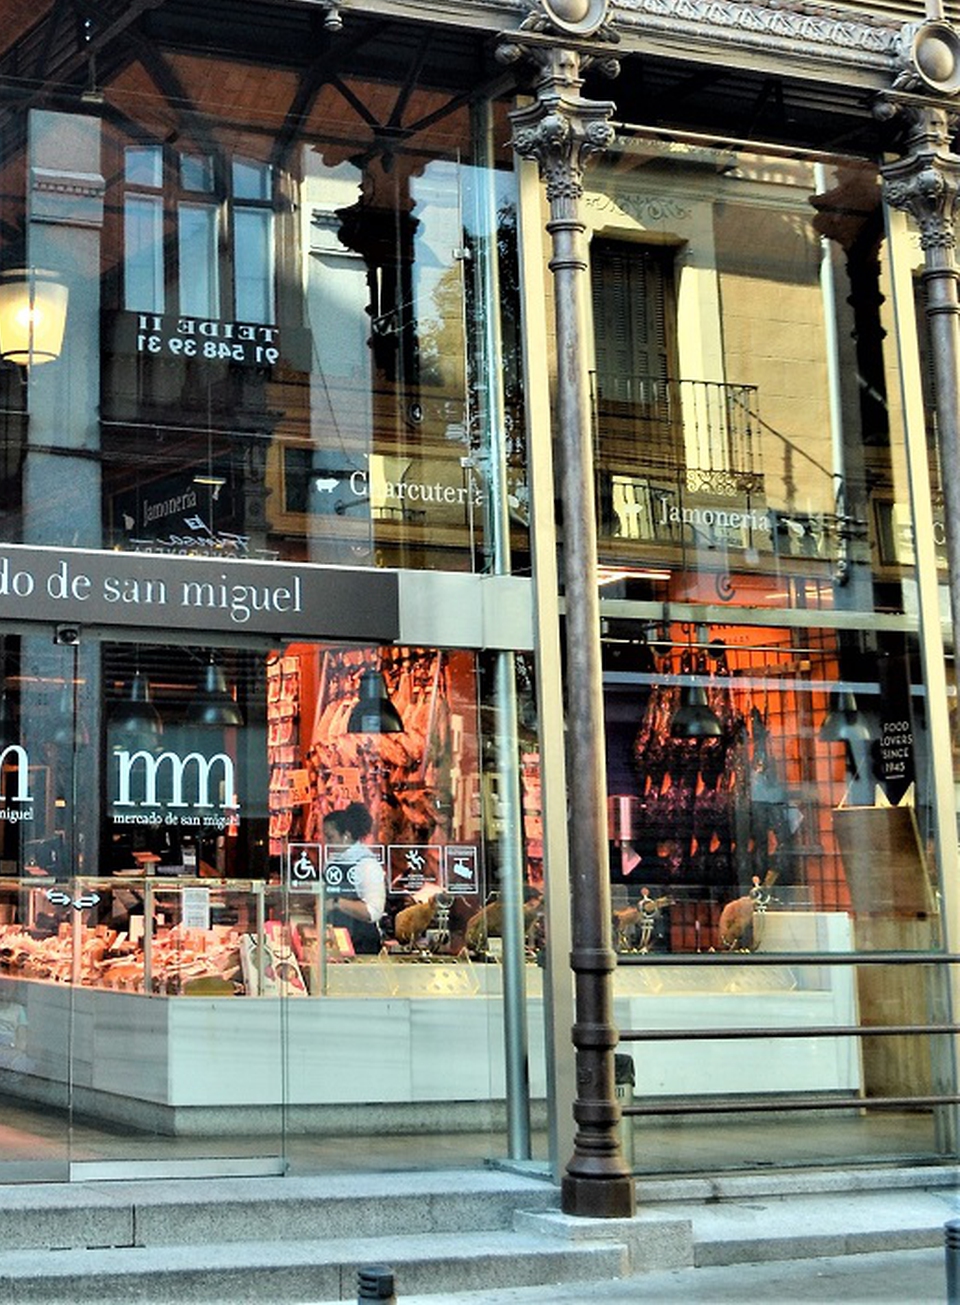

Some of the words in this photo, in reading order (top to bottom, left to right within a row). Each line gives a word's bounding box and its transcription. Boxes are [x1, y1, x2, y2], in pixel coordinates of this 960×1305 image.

[349, 471, 484, 507] Carcutera
[143, 486, 197, 527] Jamonería
[660, 497, 771, 532] Jamonería
[46, 560, 91, 601] de
[103, 576, 167, 606] san
[181, 573, 302, 623] miguel
[884, 721, 909, 733] FOOD
[880, 734, 913, 747] LOVERS
[883, 747, 909, 759] SINCE
[113, 812, 162, 825] mercado
[164, 812, 179, 825] de
[180, 816, 201, 826] san
